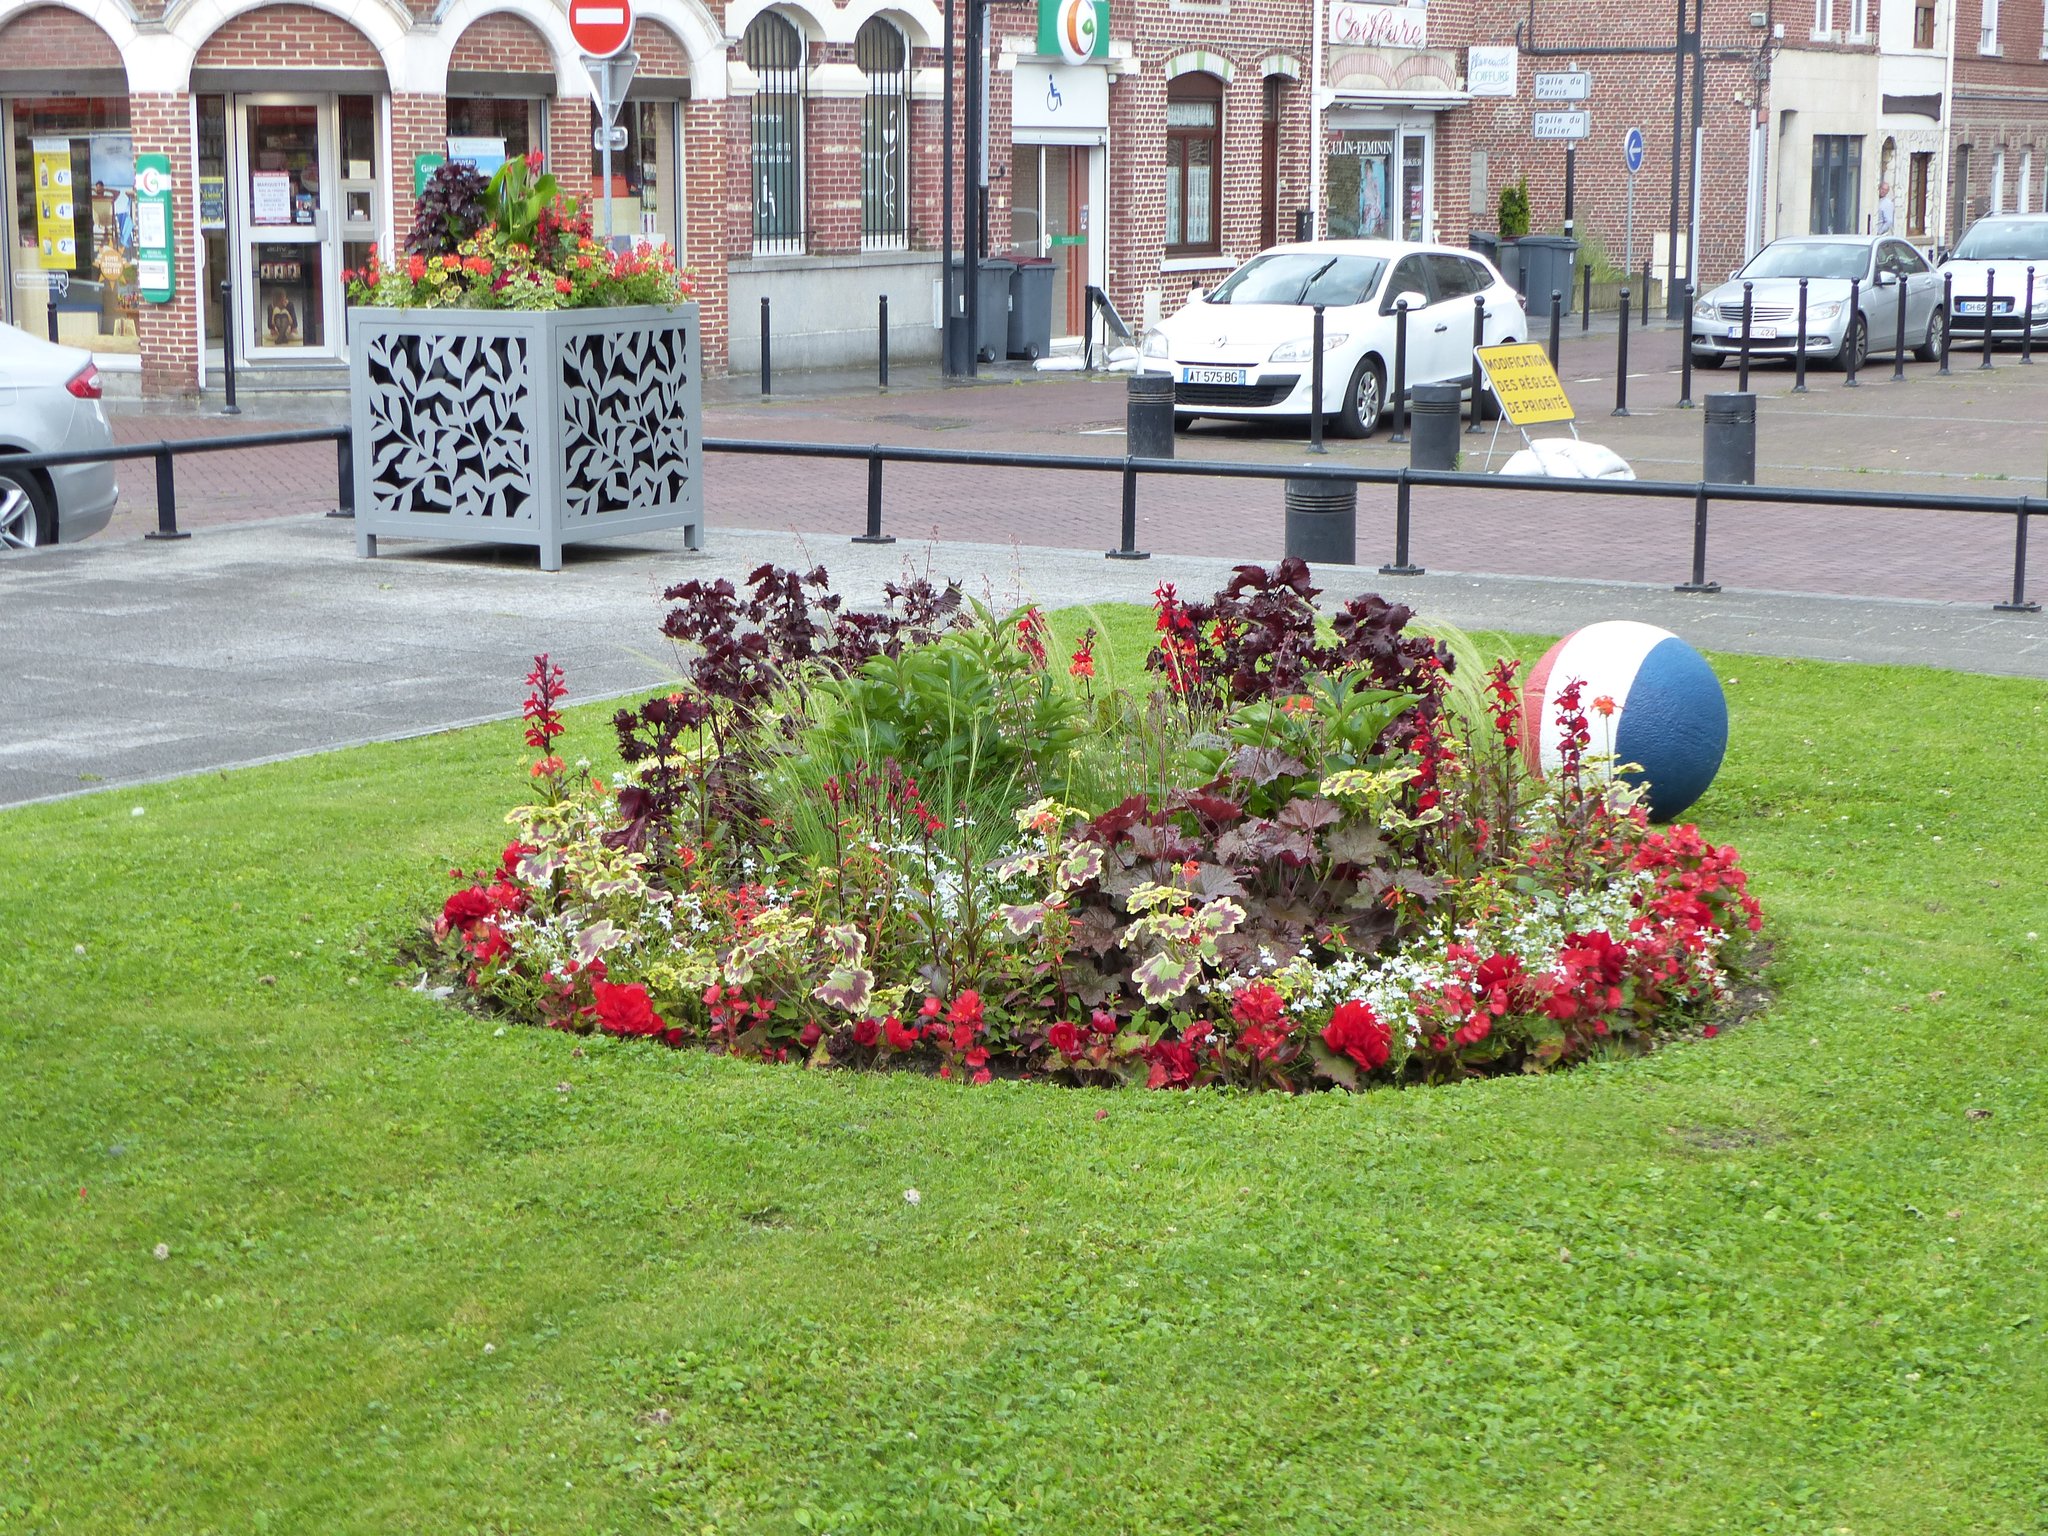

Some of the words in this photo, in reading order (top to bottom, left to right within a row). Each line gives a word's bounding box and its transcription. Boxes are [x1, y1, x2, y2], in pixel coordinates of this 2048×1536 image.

[1335, 7, 1423, 47] Coiffure
[1469, 70, 1510, 81] COIFFURE
[1538, 77, 1563, 86] Salle
[1569, 77, 1582, 86] du
[1538, 88, 1567, 96] Parvis
[1537, 116, 1562, 124] Salle
[1569, 116, 1581, 124] du
[1537, 126, 1570, 135] Blatier
[1327, 140, 1393, 155] CULIN-FEMININ
[1485, 355, 1548, 370] MODIFICATION
[1496, 378, 1519, 392] DES
[1518, 374, 1557, 390] RÈGLES
[1507, 401, 1523, 415] DE
[1522, 395, 1567, 412] PRIORITÉ
